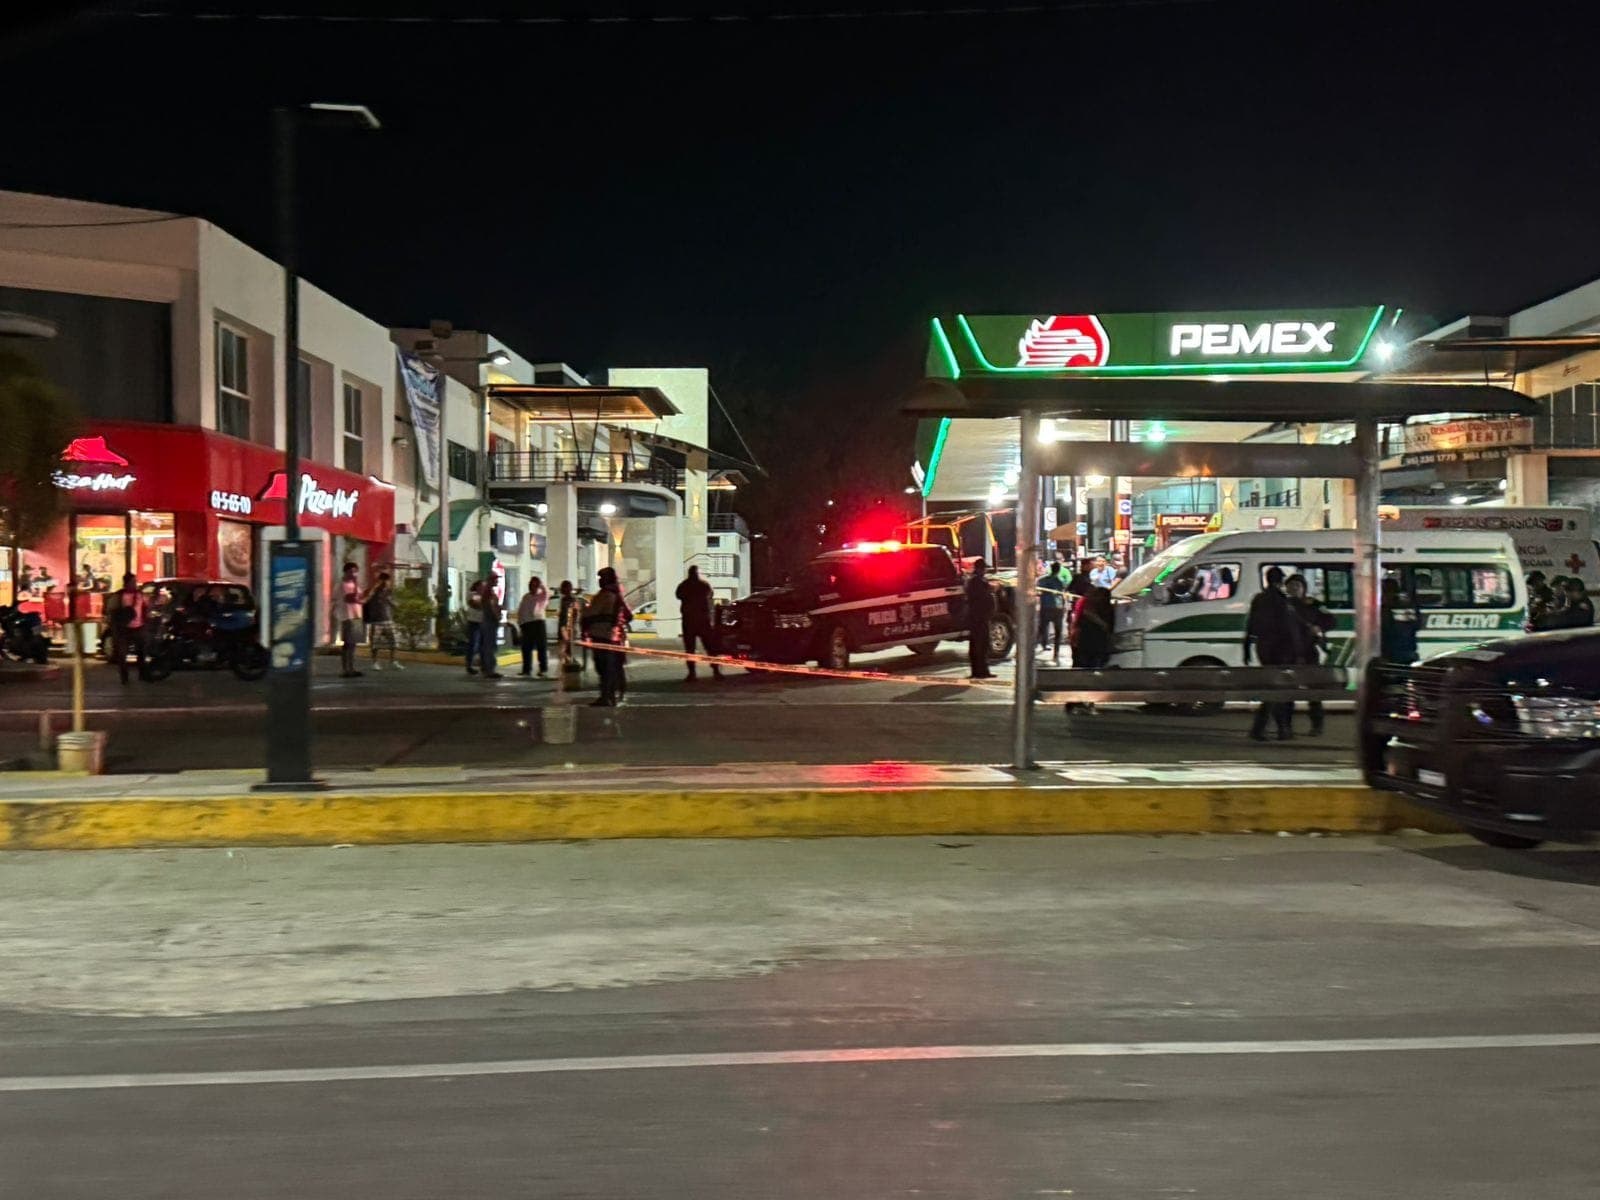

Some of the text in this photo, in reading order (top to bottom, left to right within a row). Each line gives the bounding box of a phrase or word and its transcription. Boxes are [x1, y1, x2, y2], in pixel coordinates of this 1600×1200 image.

[1171, 322, 1335, 356] PEMEX
[1466, 430, 1514, 443] RENTA
[91, 472, 137, 491] Hut
[299, 474, 359, 518] Pizza Hut
[1162, 516, 1209, 526] PEMEX
[882, 621, 931, 636] CHIAPAS
[1427, 614, 1499, 628] COLECTIVO
